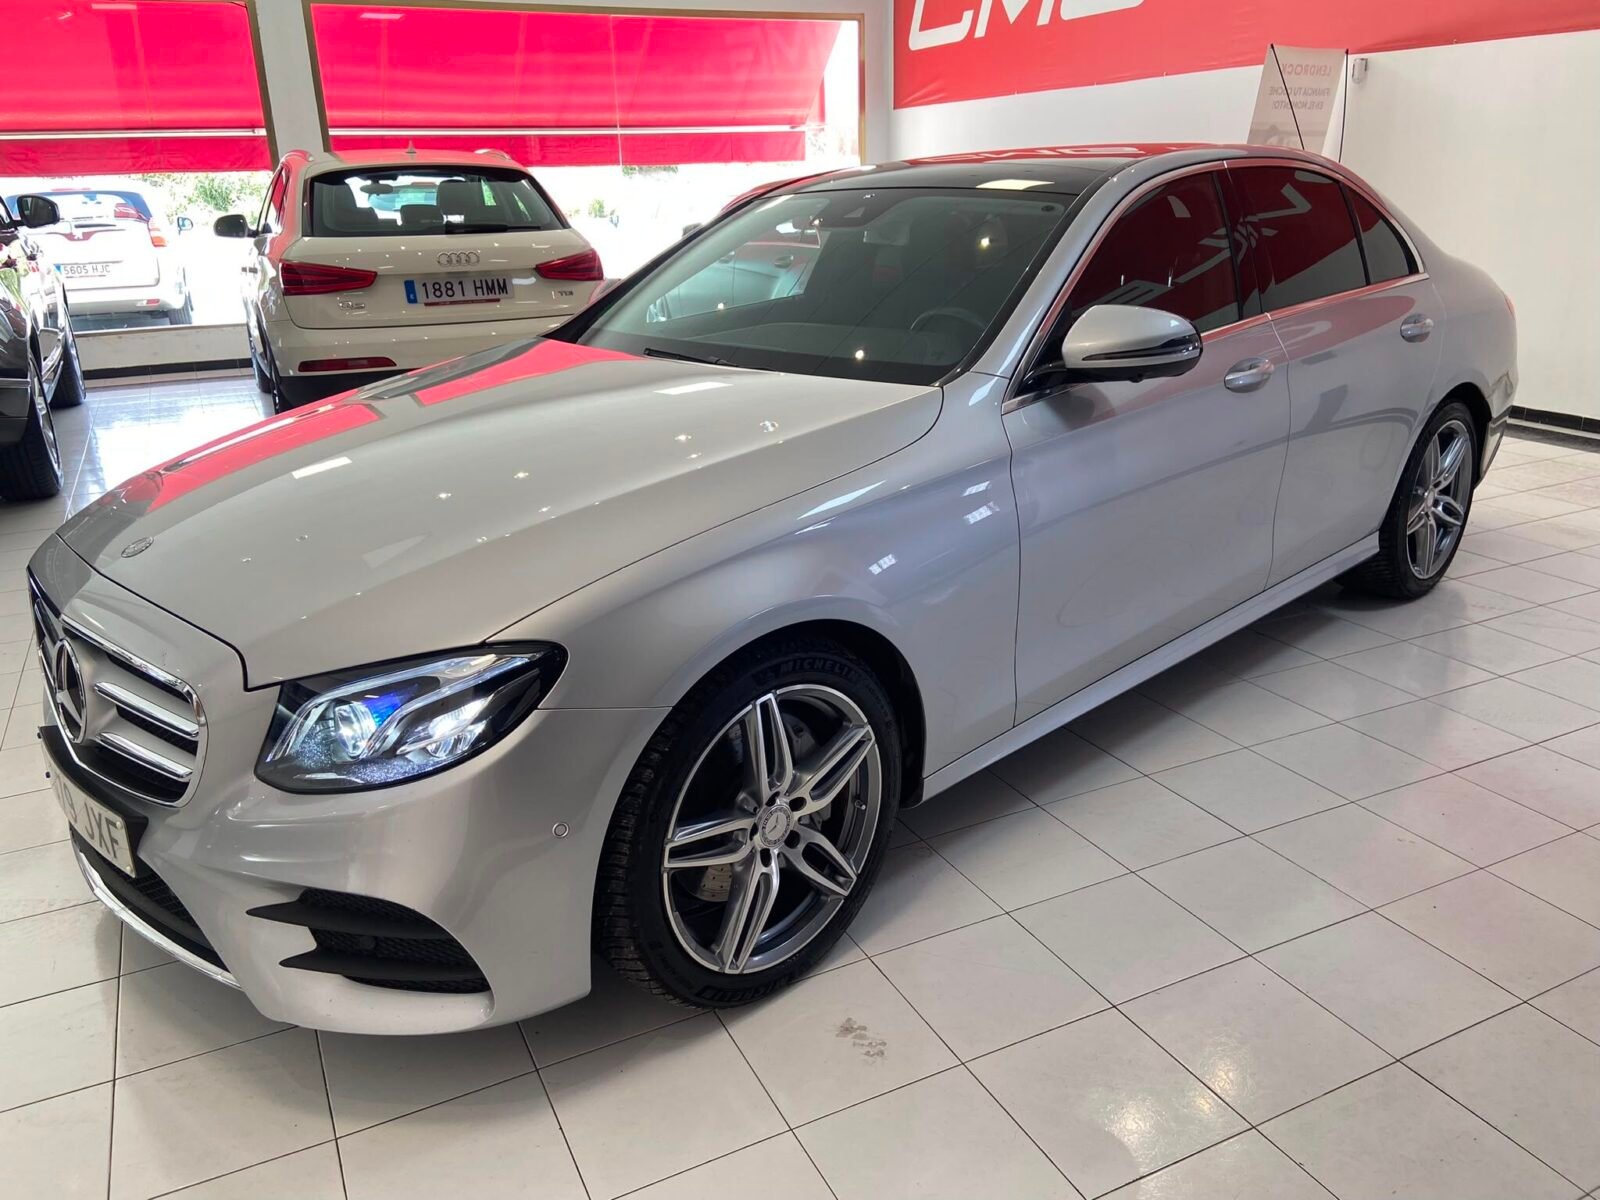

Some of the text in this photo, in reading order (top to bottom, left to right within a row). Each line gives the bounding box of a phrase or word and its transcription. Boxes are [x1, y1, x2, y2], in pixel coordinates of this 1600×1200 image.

[63, 264, 111, 275] 5605 HJC
[421, 277, 509, 299] 1881 HMM
[84, 801, 119, 859] JXF
